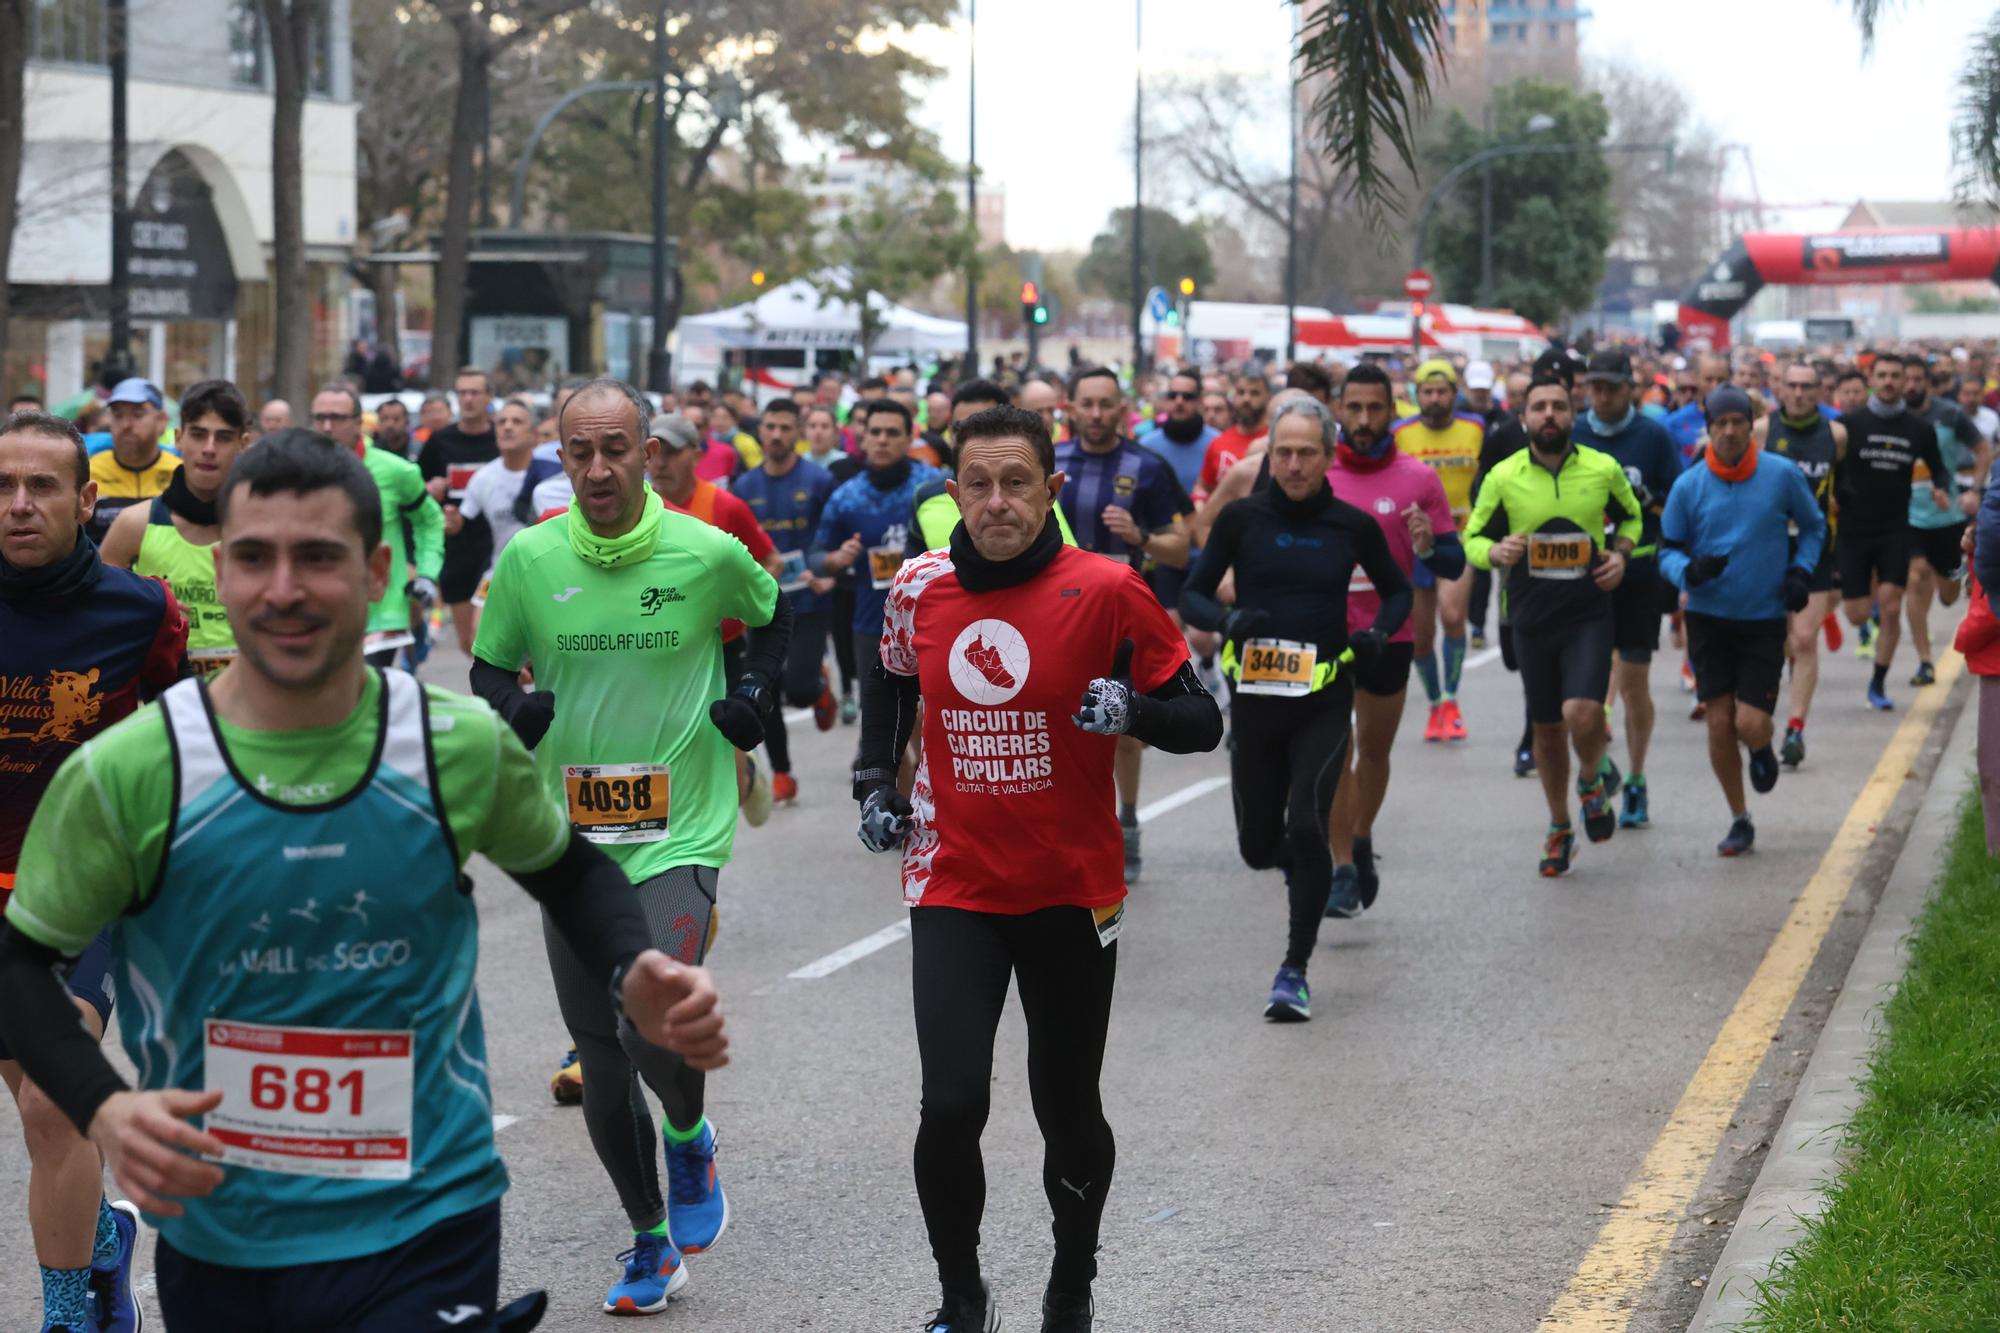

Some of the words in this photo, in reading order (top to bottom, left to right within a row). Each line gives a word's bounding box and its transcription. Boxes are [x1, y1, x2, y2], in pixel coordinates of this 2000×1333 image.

[557, 630, 679, 651] SUSODELAFUENTE
[1251, 649, 1300, 673] 3446
[941, 708, 1020, 732] CIRCUIT
[1024, 711, 1048, 730] DE
[947, 731, 1051, 757] CARRERES
[952, 755, 1052, 783] POPULARS
[578, 778, 652, 812] 4038
[956, 782, 985, 793] CIUTAT
[987, 785, 1000, 796] DE
[1001, 779, 1053, 795] VALÈNCIA
[240, 946, 298, 974] VALL
[333, 939, 411, 972] SEGO
[251, 1064, 364, 1116] 681
